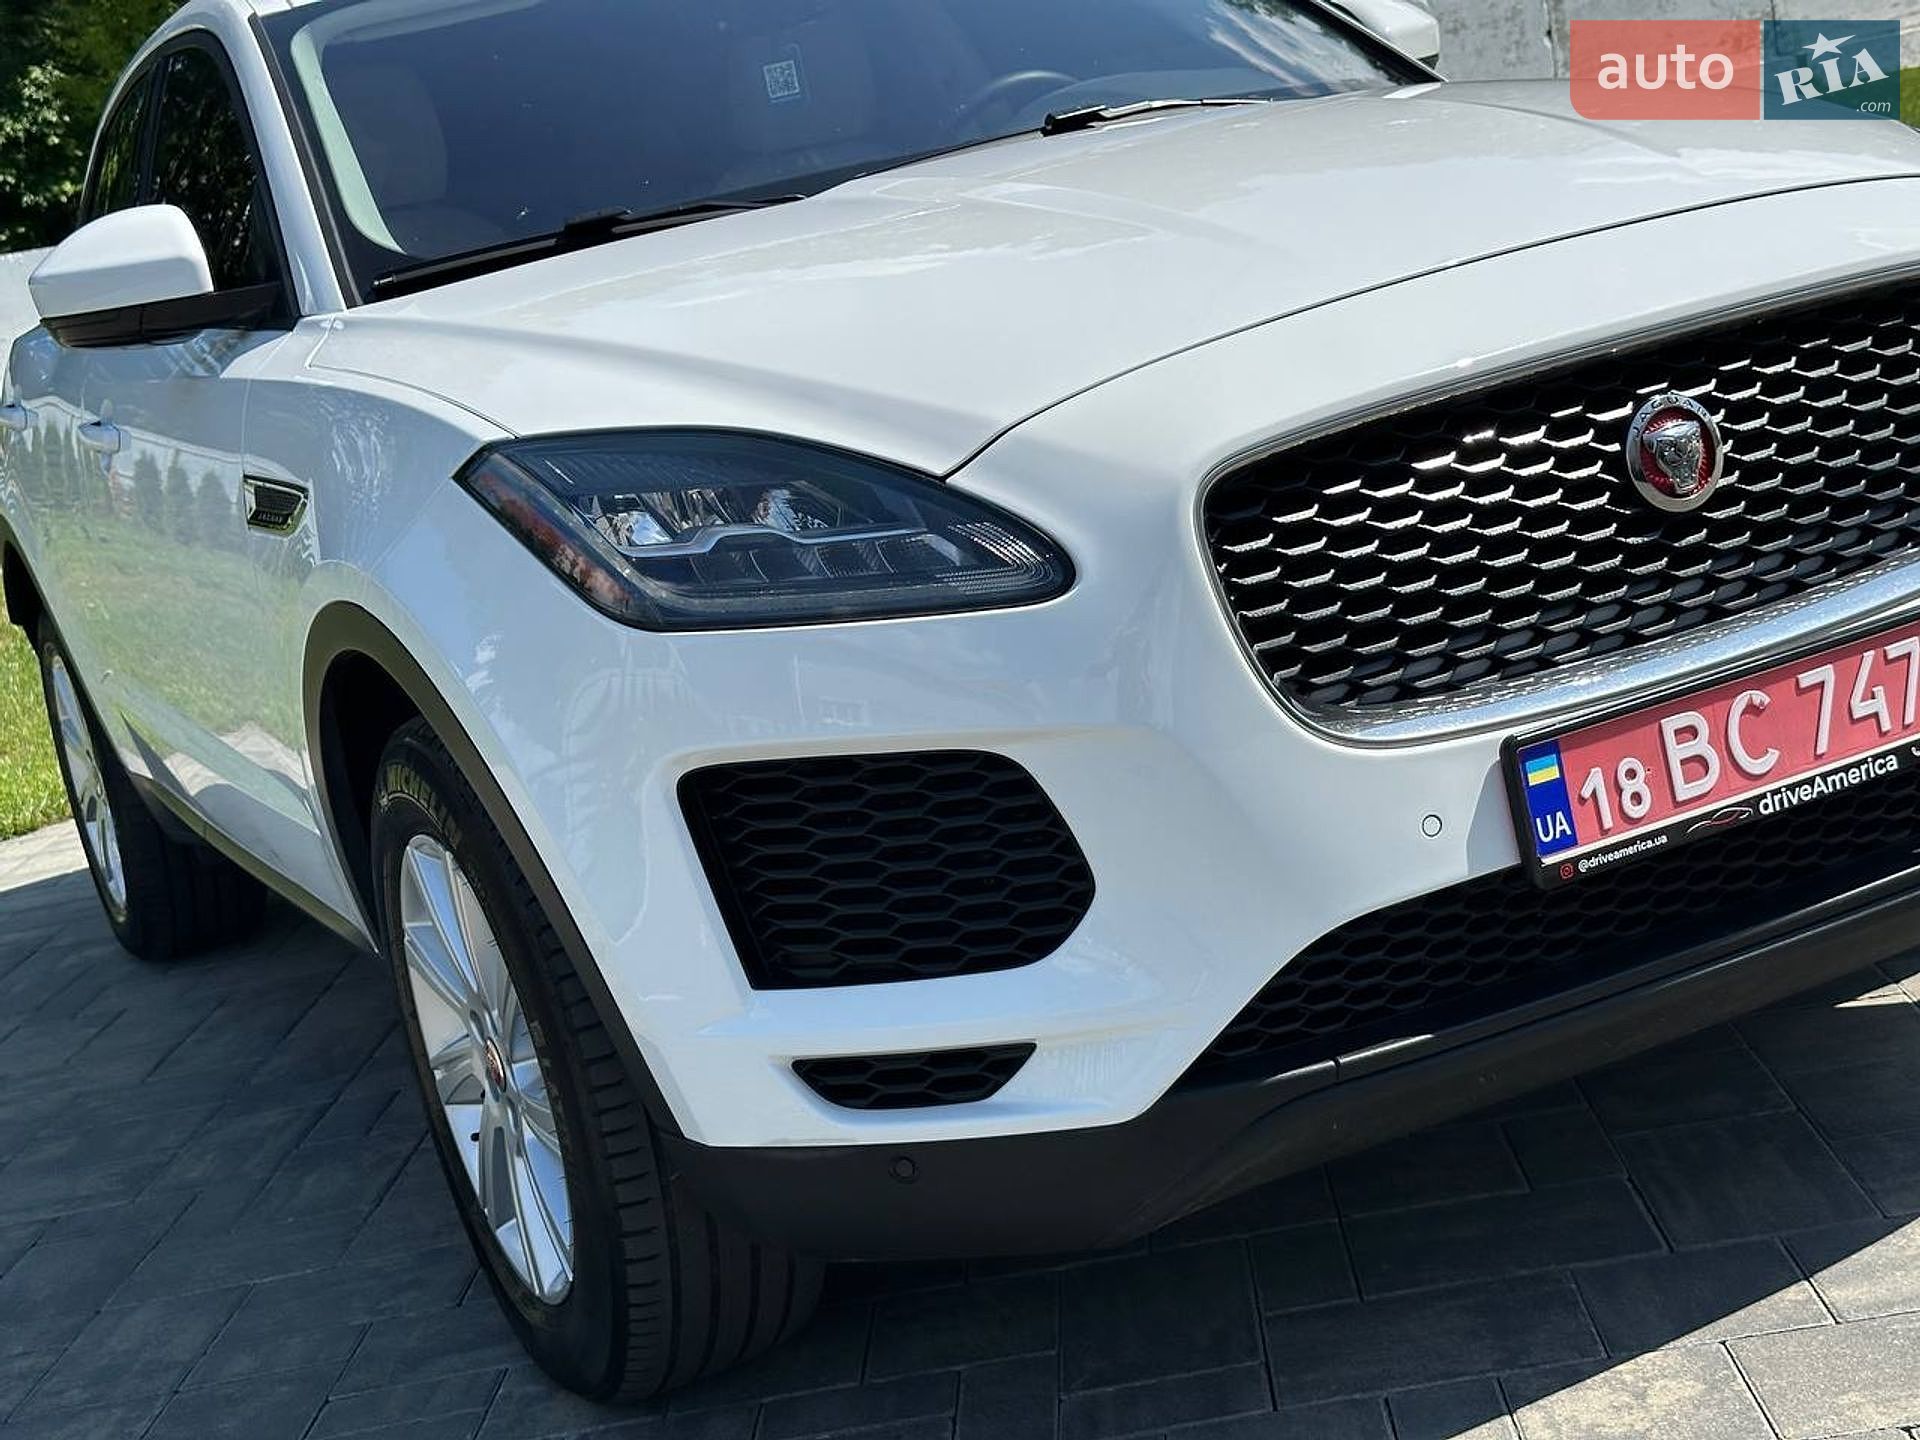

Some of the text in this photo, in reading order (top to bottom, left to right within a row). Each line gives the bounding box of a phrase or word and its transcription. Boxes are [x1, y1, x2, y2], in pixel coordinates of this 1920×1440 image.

[1580, 636, 1920, 830] 18 BC 747
[1759, 753, 1899, 816] driveAmerica
[1536, 811, 1572, 843] UA
[1578, 834, 1668, 873] @driveamerica.ua
